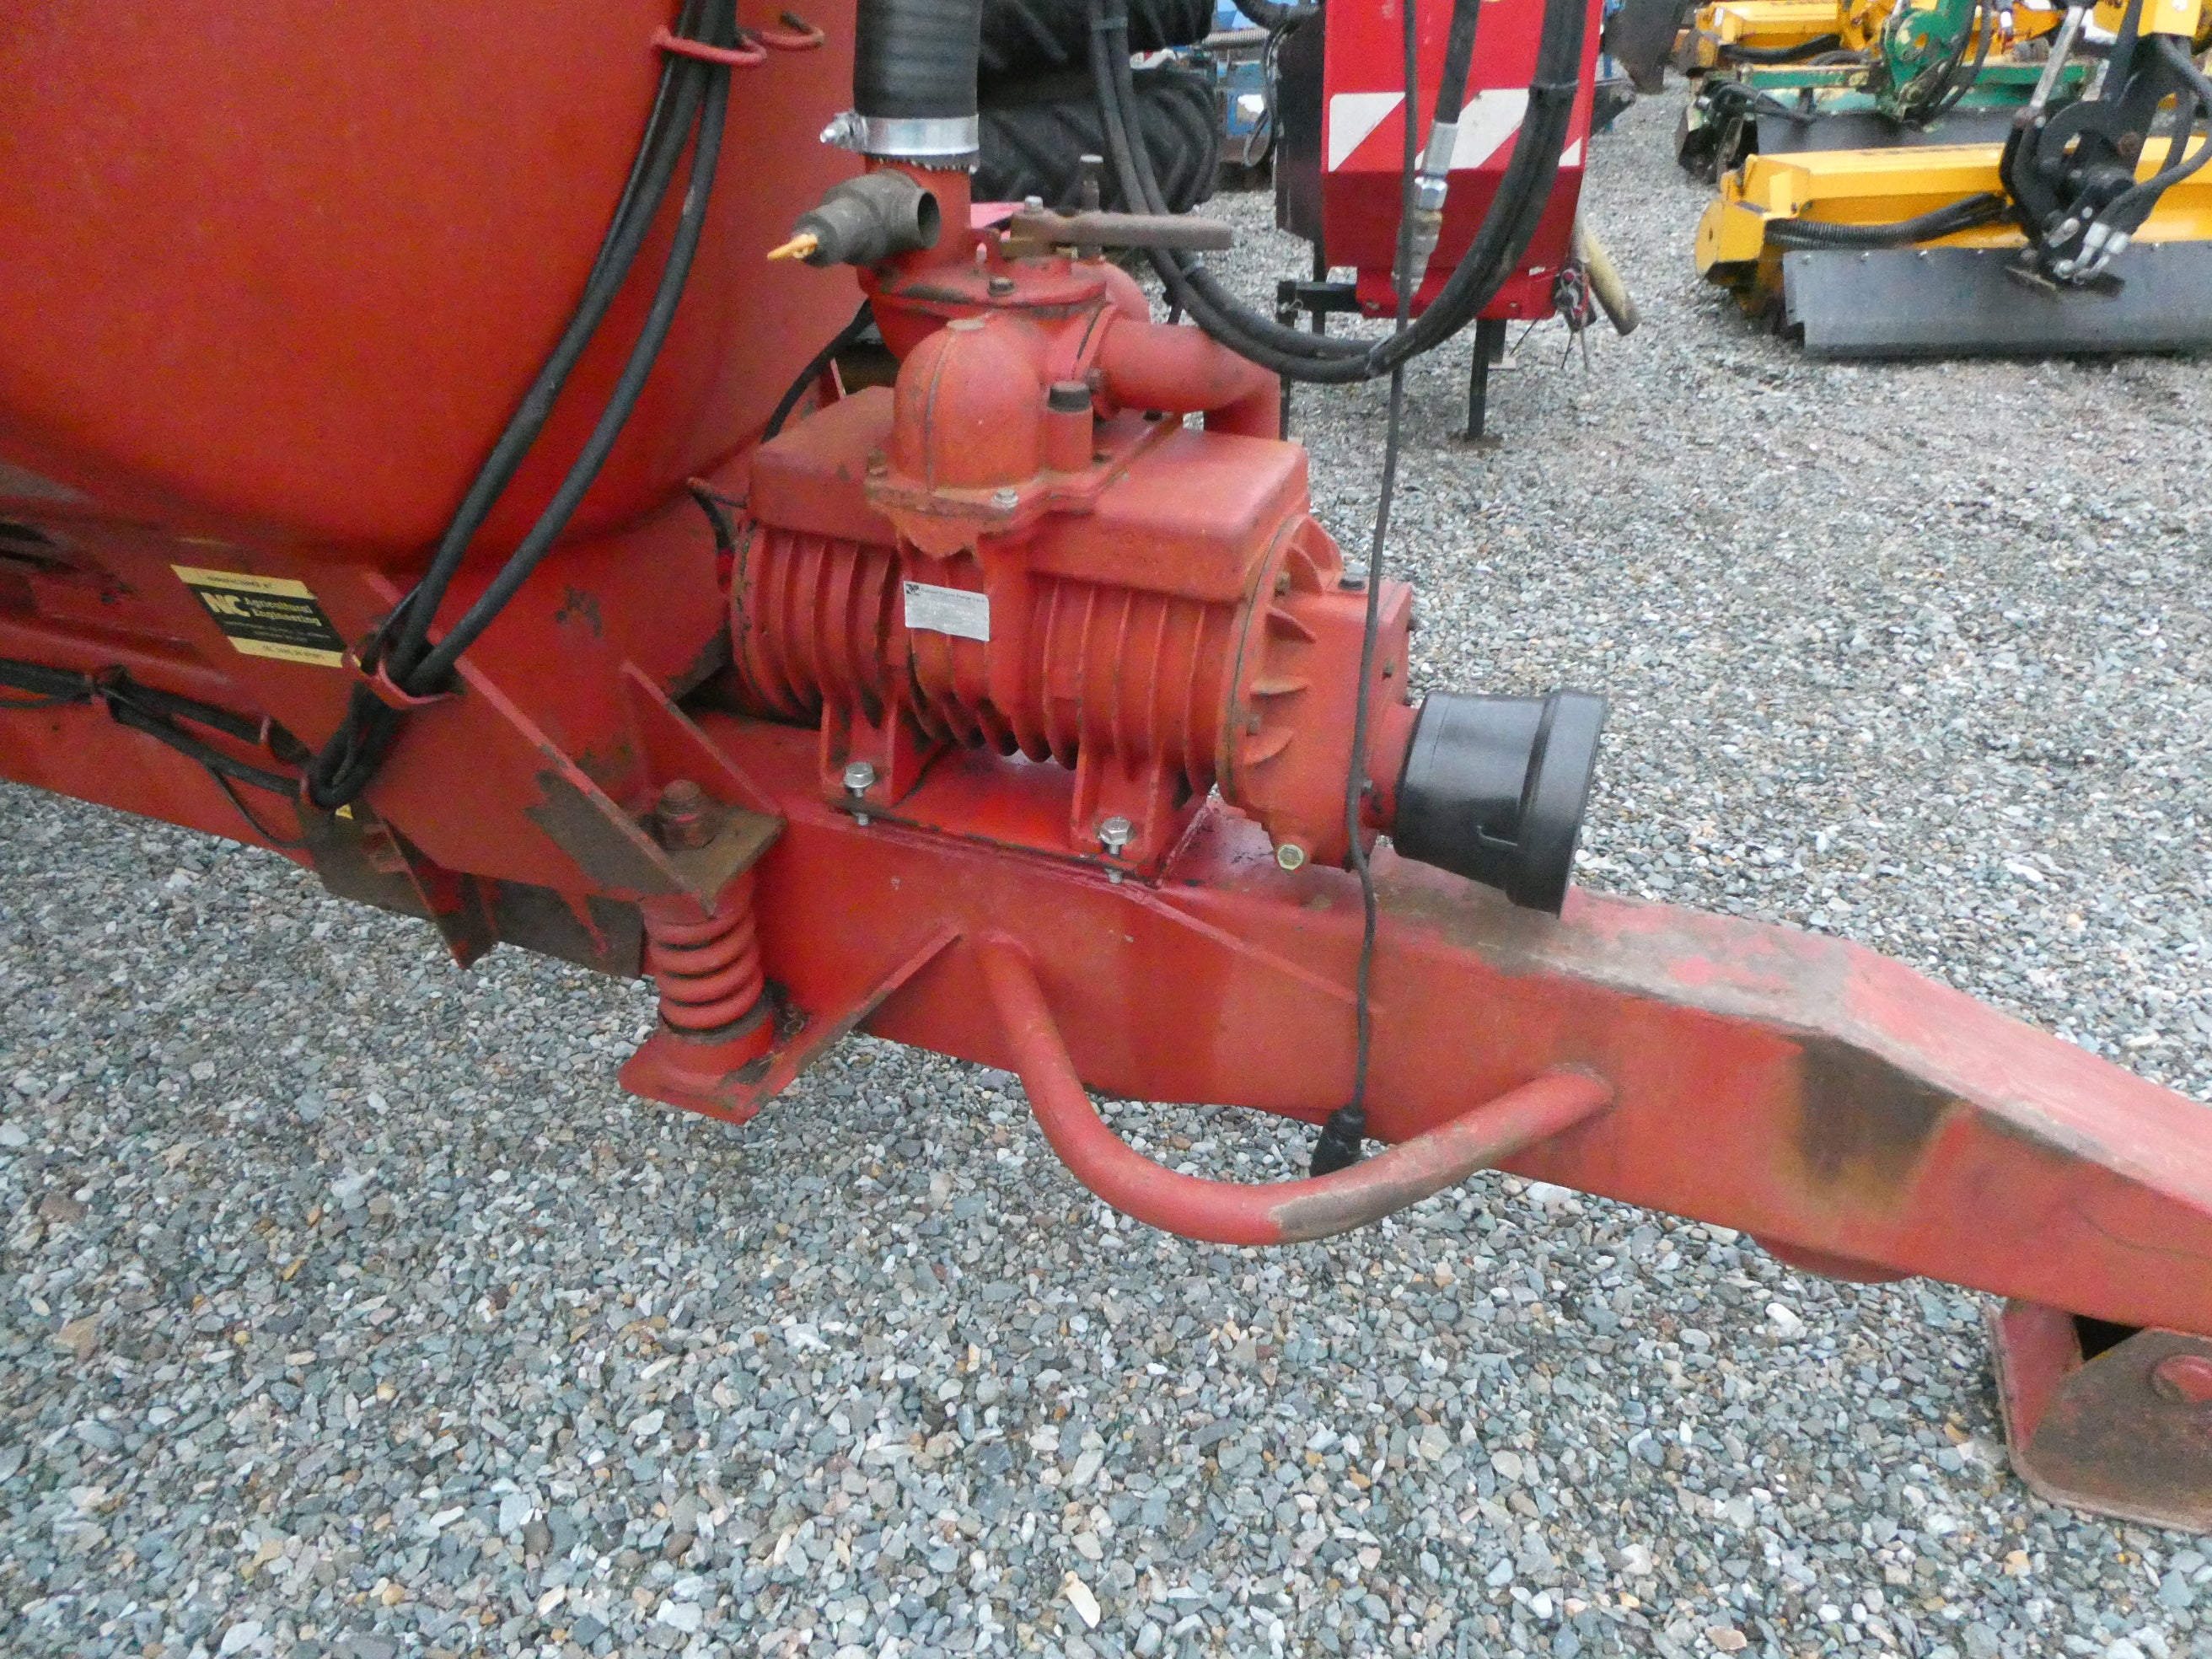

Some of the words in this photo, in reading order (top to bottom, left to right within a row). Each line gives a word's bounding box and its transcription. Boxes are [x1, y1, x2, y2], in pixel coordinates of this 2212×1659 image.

[201, 592, 250, 618] NC
[244, 597, 314, 614] Agricultural
[251, 609, 323, 627] Engineering
